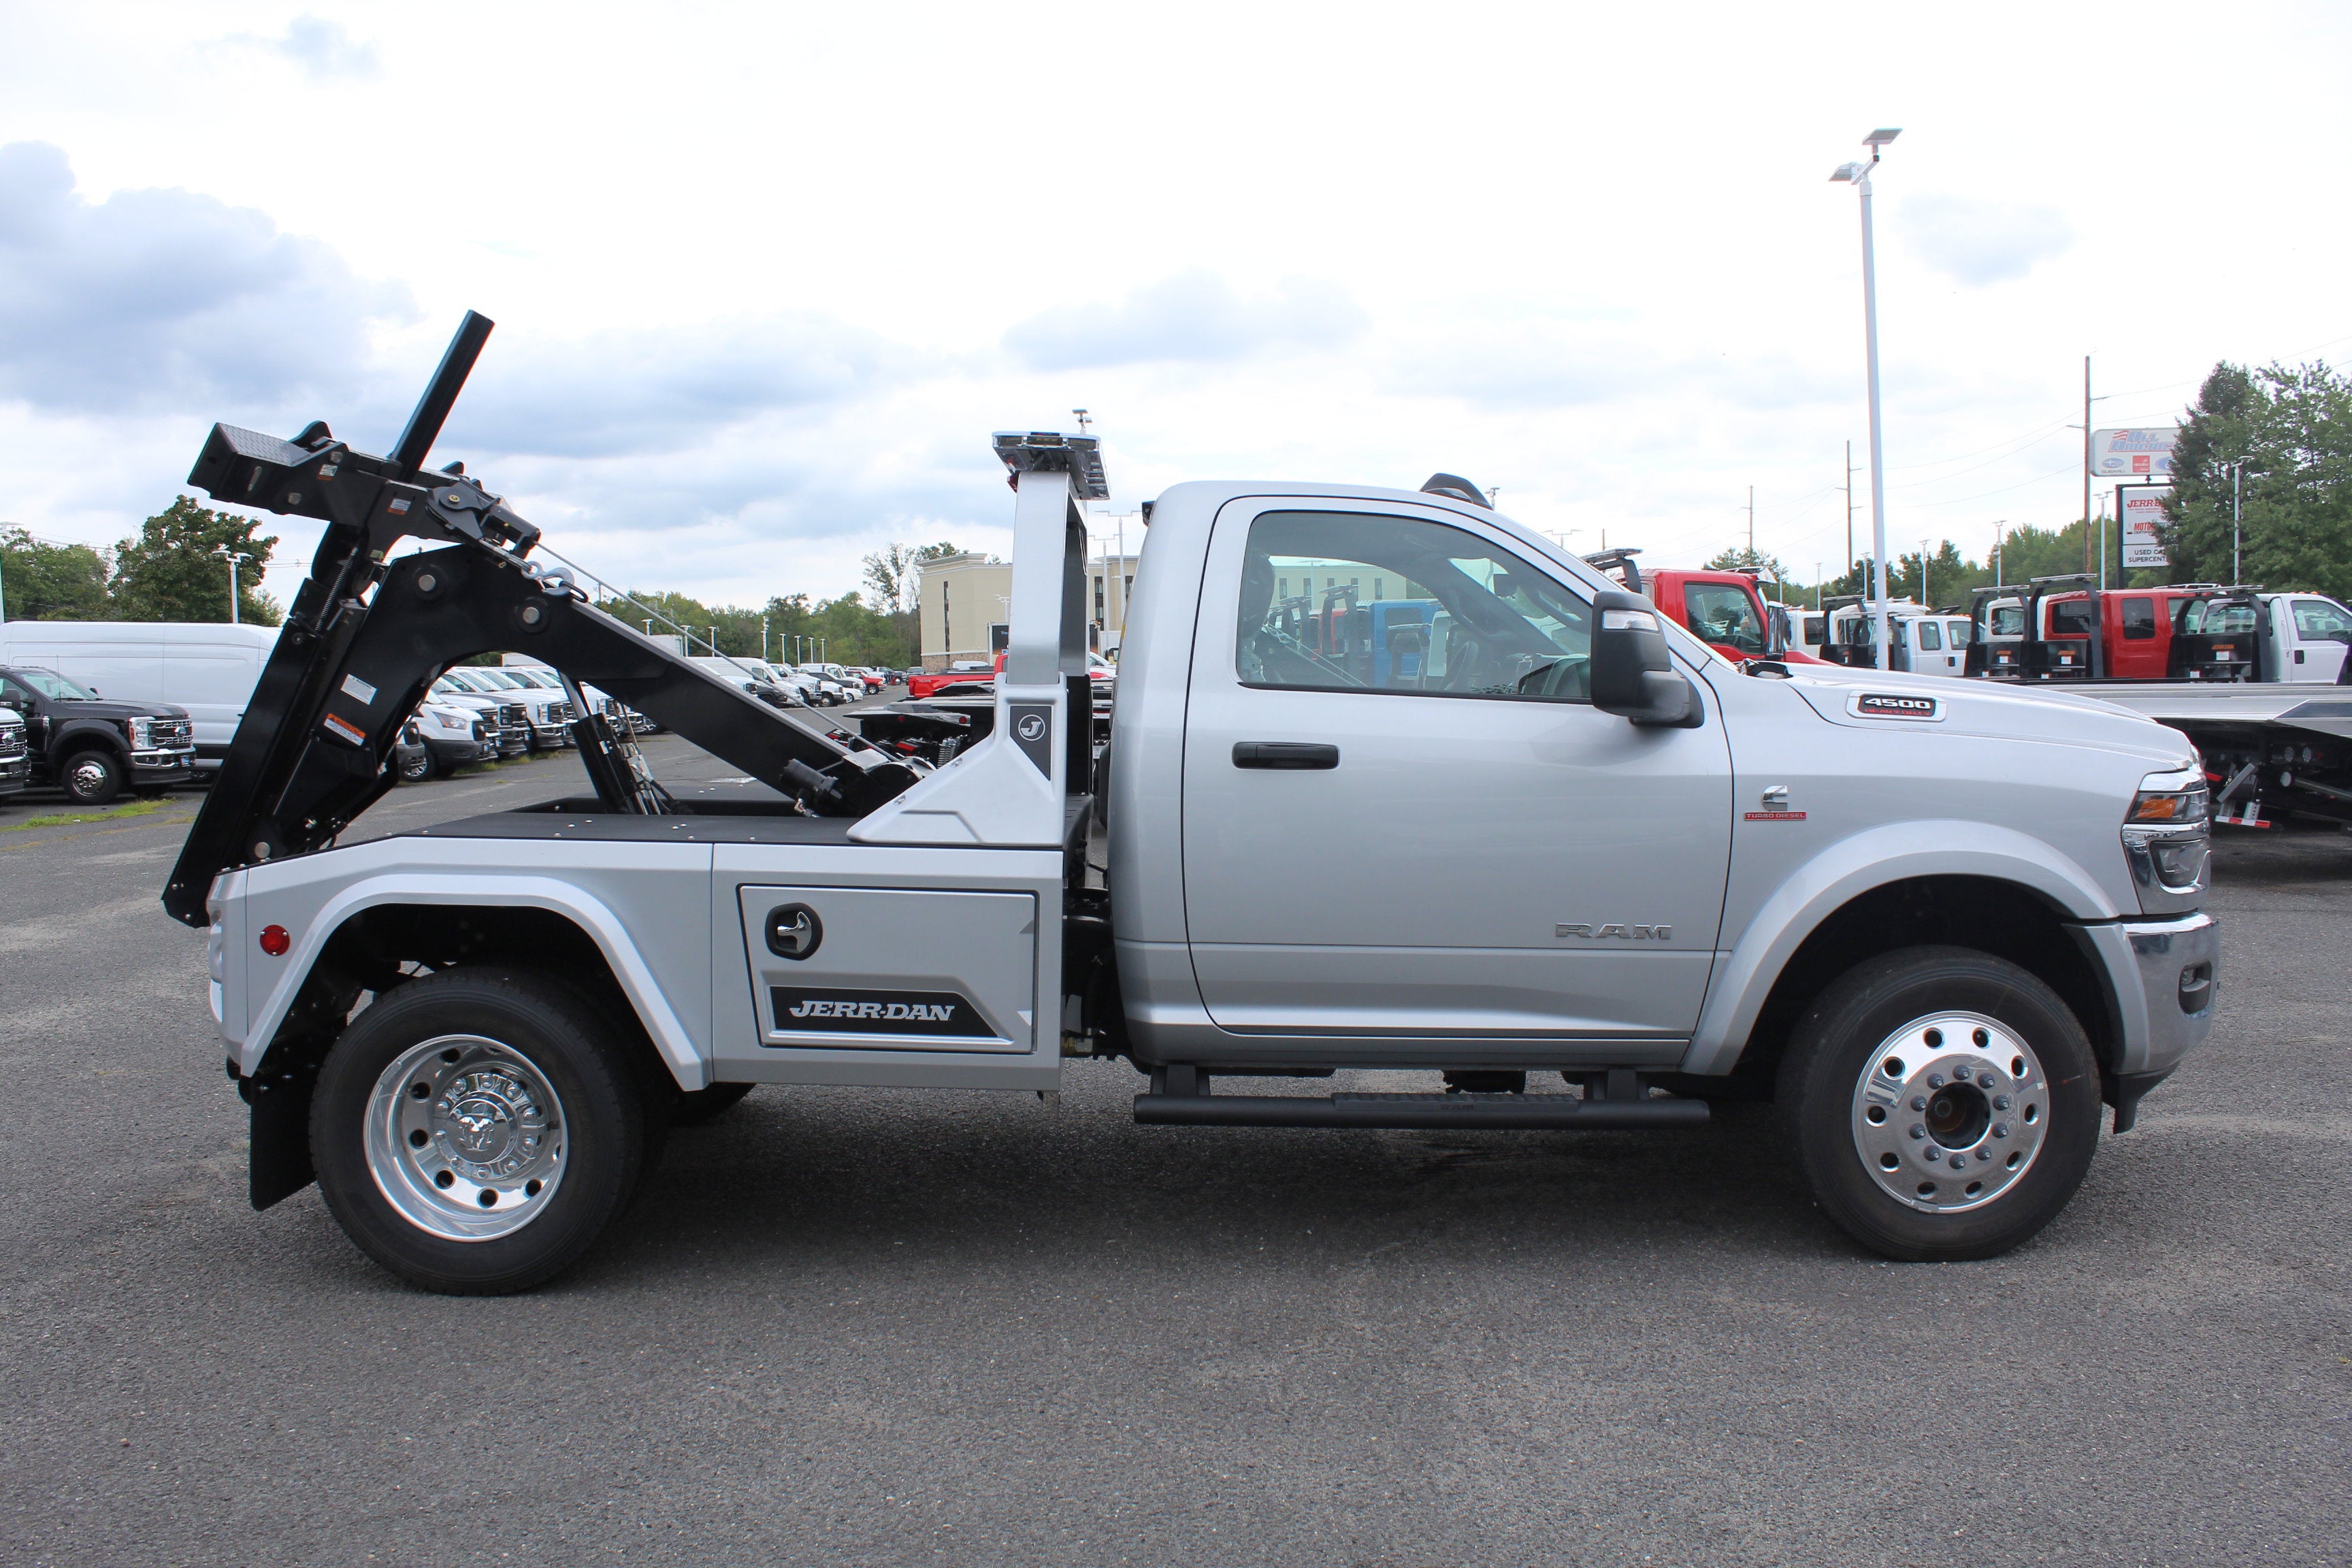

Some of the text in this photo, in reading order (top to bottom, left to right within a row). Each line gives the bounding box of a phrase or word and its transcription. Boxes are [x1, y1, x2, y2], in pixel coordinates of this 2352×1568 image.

[2108, 439, 2174, 453] AMERIC
[2127, 499, 2162, 508] JERR-D
[1865, 698, 1931, 709] 4500
[1556, 922, 1672, 940] RAM
[789, 1000, 955, 1021] JERR-DAN
